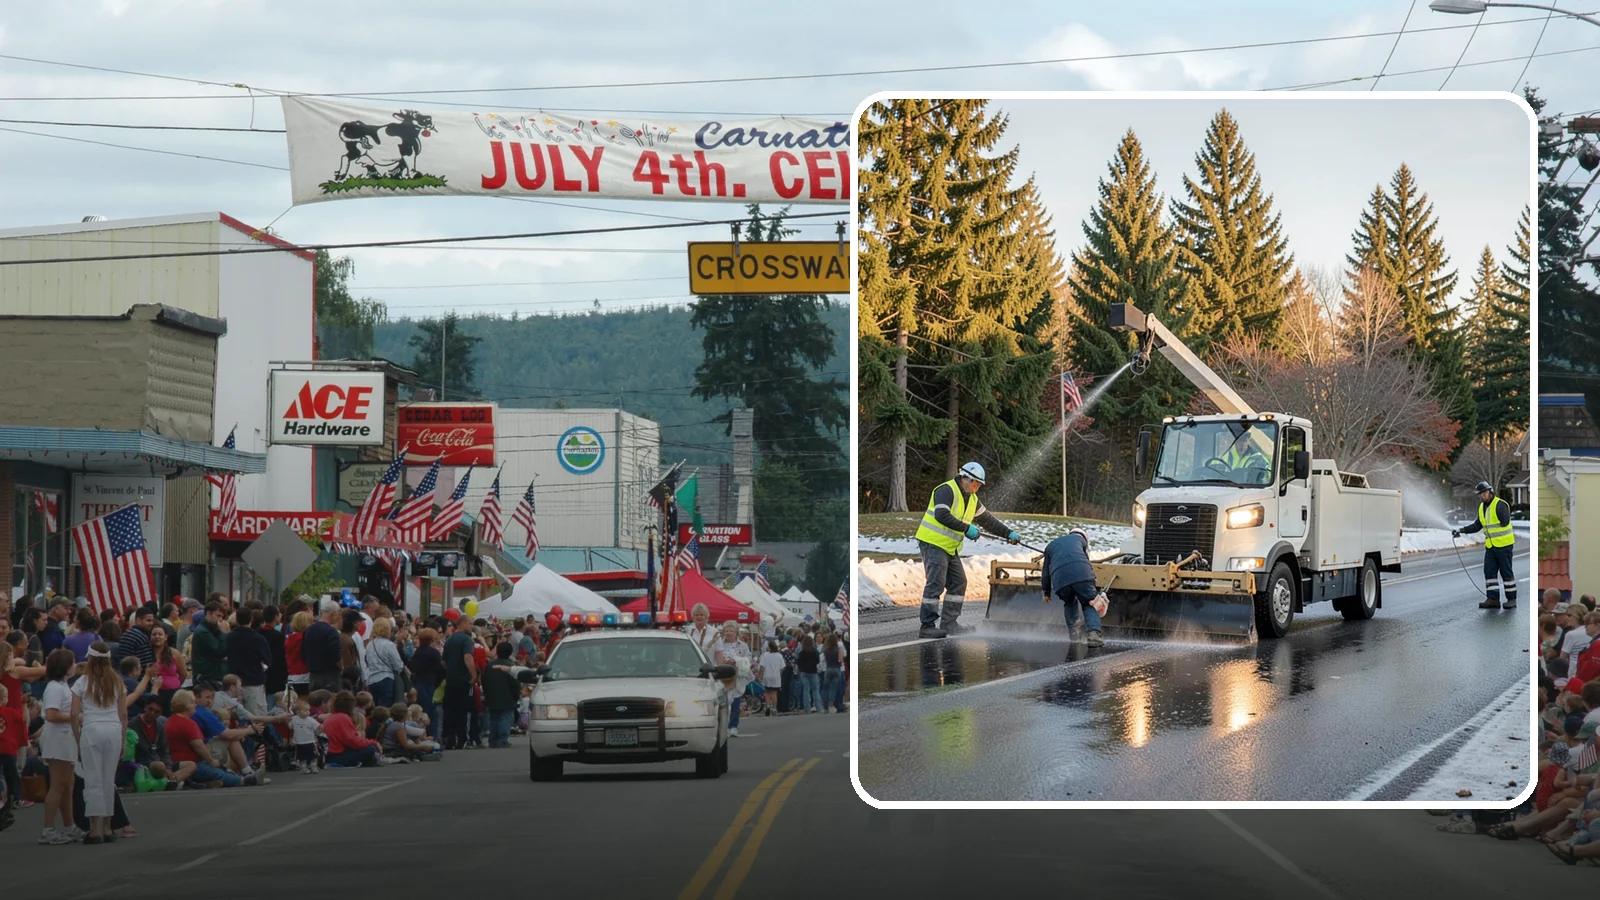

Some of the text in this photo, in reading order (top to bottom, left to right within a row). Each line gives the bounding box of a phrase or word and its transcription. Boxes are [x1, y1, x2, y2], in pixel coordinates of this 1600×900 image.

[481, 141, 605, 193] JULY
[632, 149, 747, 198] 4th.
[696, 254, 850, 280] CROSSWA
[283, 380, 374, 420] ACE
[406, 409, 485, 422] CEDAR LOG
[283, 421, 371, 437] Hardware
[95, 485, 125, 495] Vincent
[126, 486, 136, 495] de
[137, 486, 155, 495] Paul
[699, 535, 731, 543] GLASS
